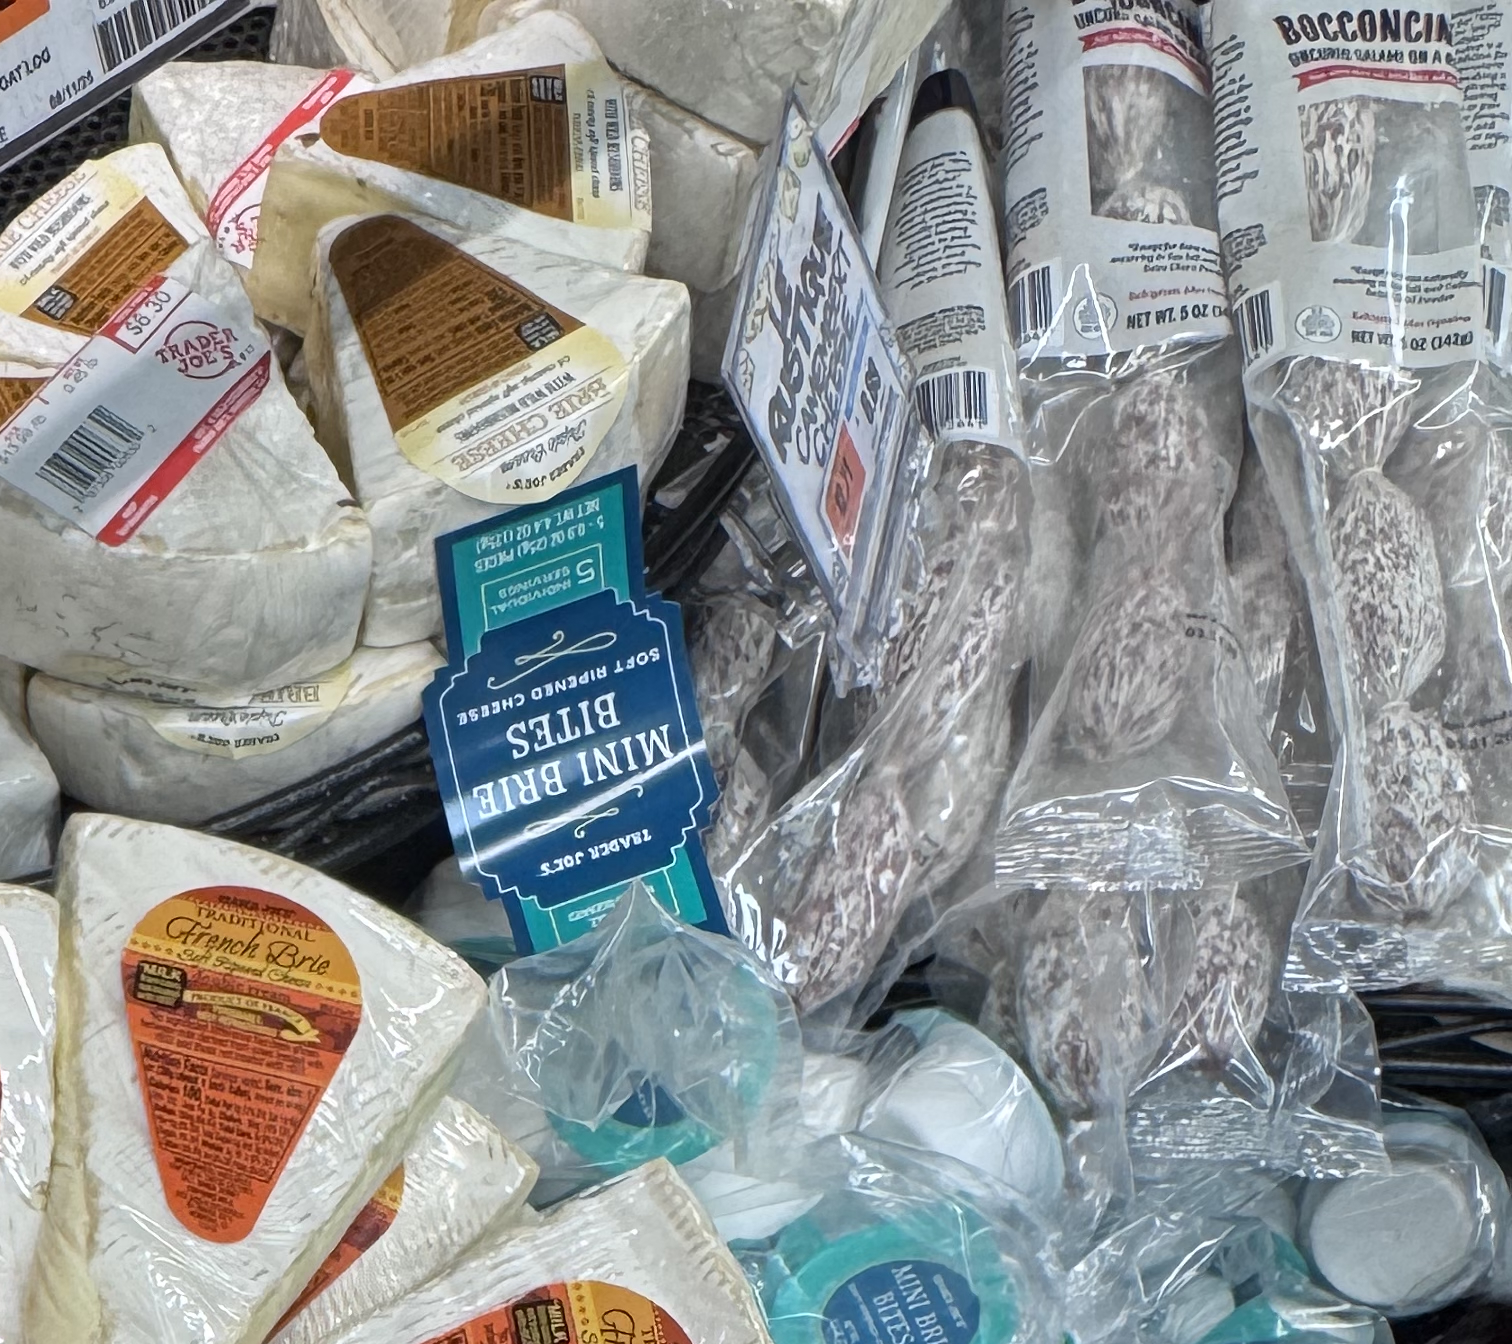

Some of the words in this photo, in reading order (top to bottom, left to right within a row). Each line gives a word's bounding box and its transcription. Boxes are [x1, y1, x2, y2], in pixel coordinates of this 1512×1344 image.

[155, 328, 238, 364] TRADER
[447, 413, 548, 471] CHEESE
[576, 559, 595, 584] 5
[614, 648, 659, 673] SOFT
[531, 666, 607, 700] RIPENED
[457, 694, 525, 725] CHEESE
[506, 692, 620, 759] BITES
[576, 724, 679, 785] MINI
[472, 760, 567, 821] BRIE
[588, 829, 651, 859] TRADER
[166, 916, 261, 958] French
[266, 941, 330, 975] Brie
[892, 1265, 930, 1310] MINI
